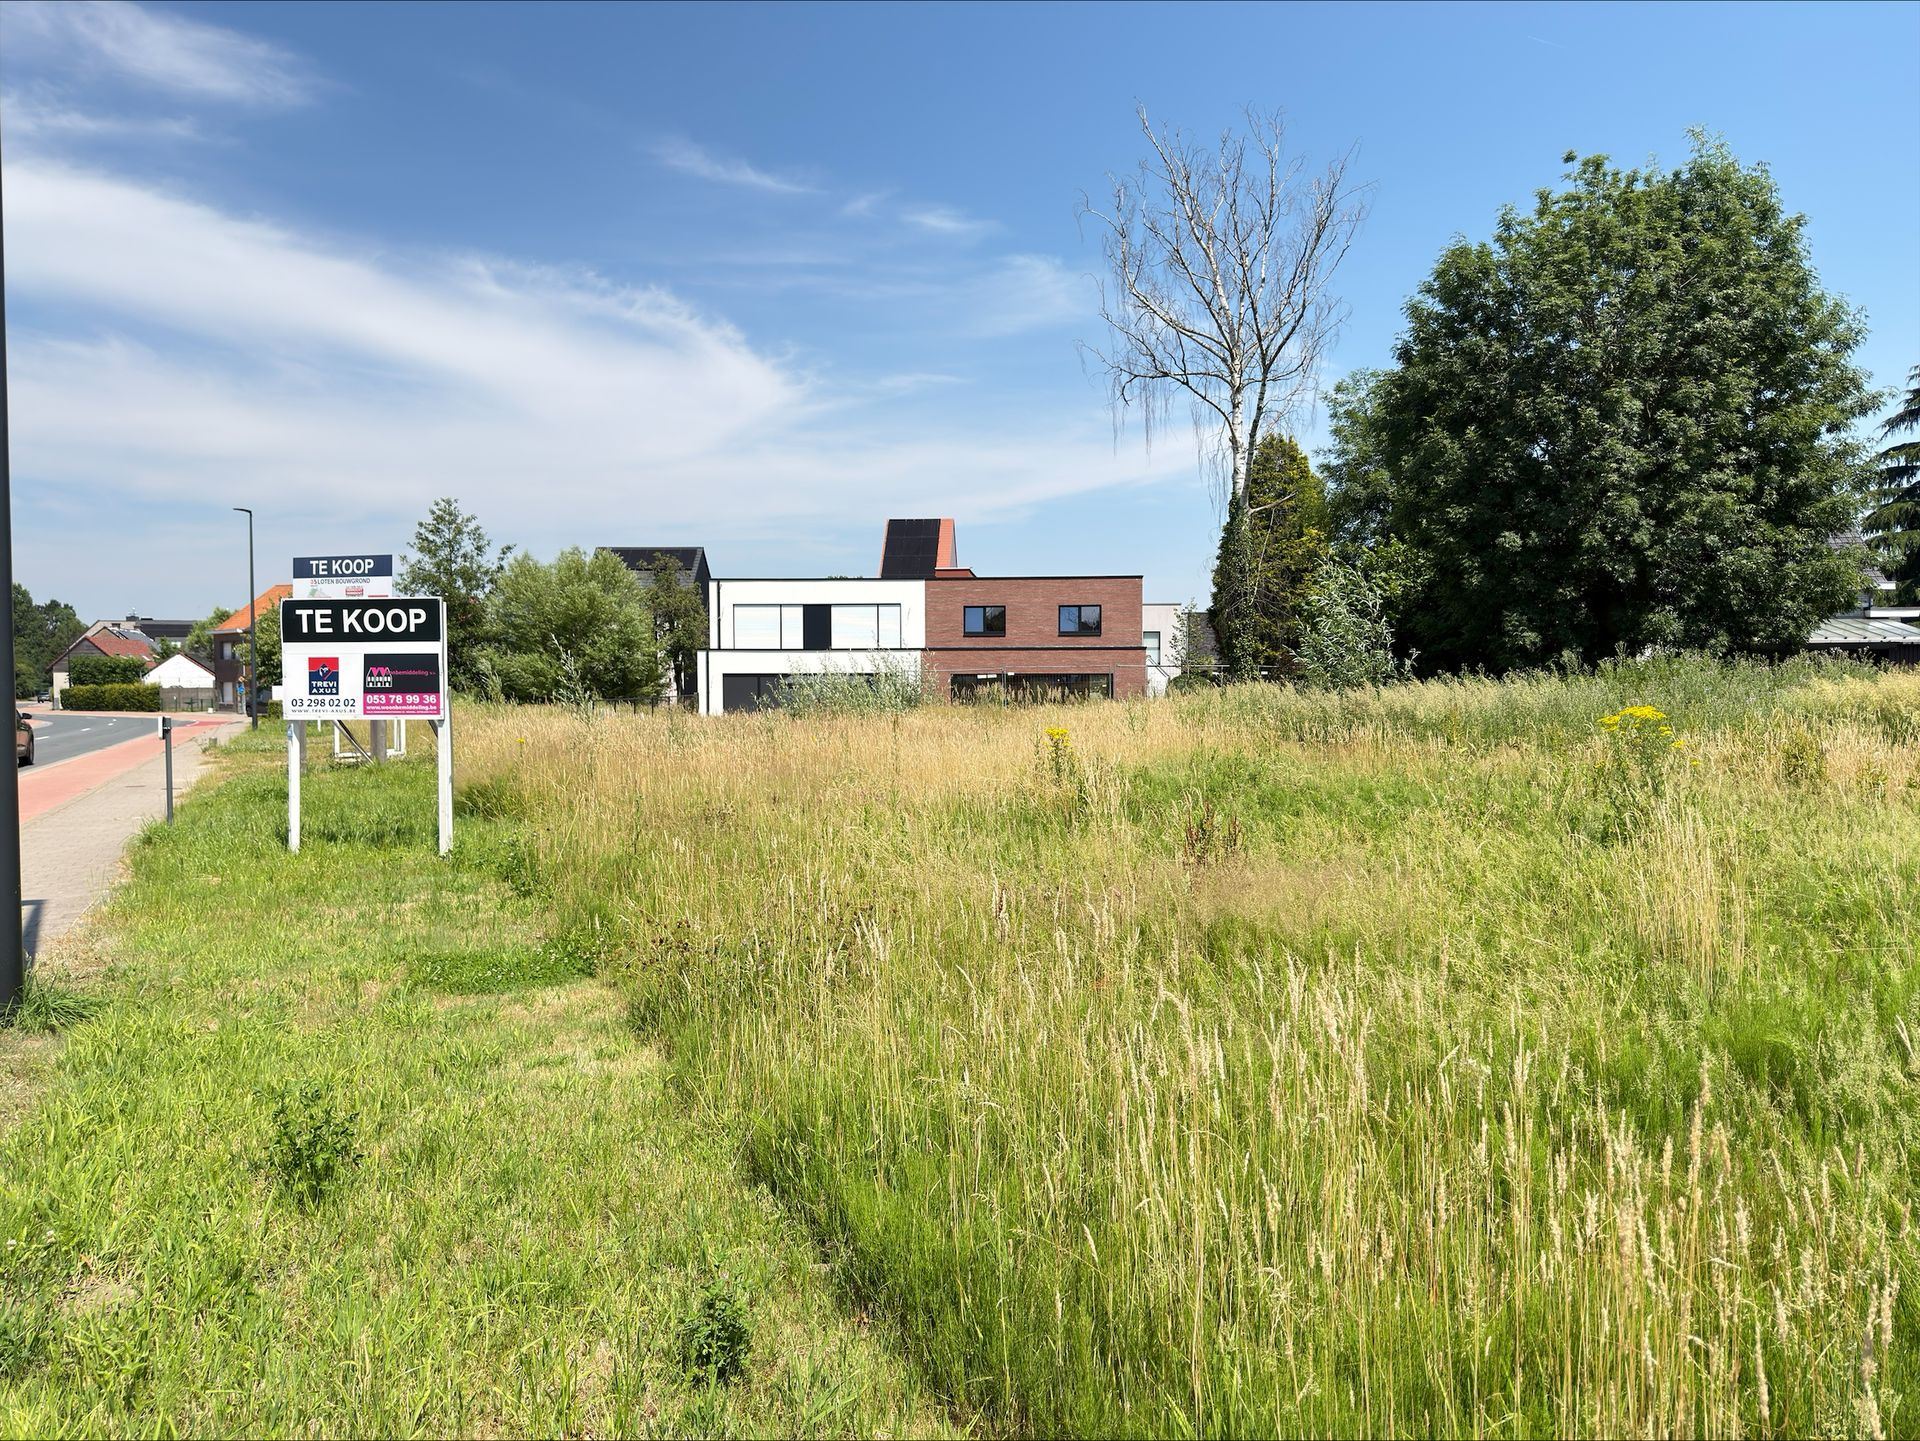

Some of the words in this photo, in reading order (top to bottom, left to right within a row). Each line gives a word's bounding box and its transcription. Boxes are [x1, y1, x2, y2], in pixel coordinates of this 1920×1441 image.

[309, 560, 328, 575] TE
[332, 559, 374, 574] KOOP
[295, 609, 333, 633] TE
[342, 608, 427, 633] KOOP
[291, 698, 304, 707] 03
[306, 698, 326, 707] 298
[328, 698, 341, 707] 02
[343, 698, 356, 707] 02
[366, 695, 386, 704] 053
[389, 695, 403, 704] 78
[405, 695, 420, 704] 99
[422, 695, 437, 704] 36
